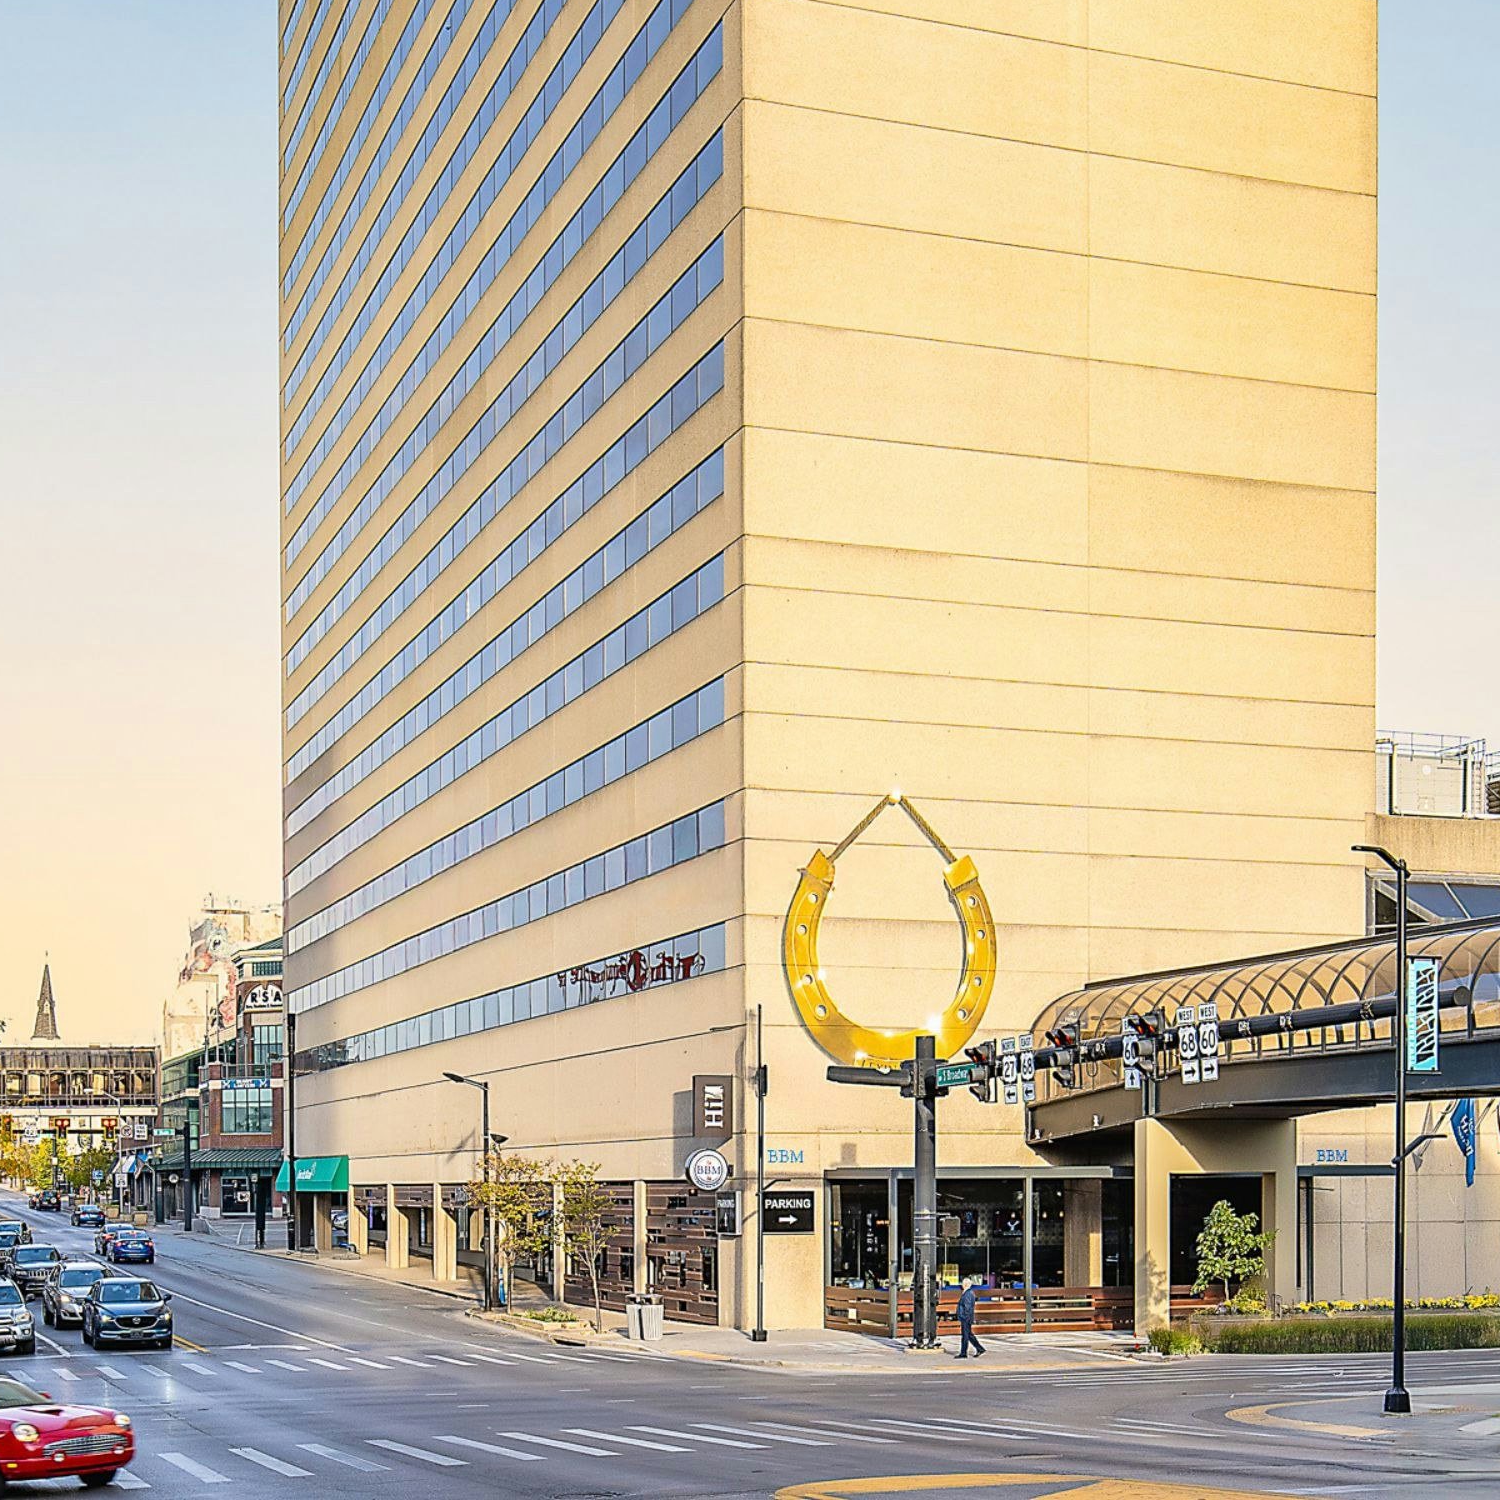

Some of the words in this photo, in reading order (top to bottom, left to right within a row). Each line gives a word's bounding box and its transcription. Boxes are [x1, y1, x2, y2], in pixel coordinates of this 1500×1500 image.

[1179, 1009, 1193, 1020] WEST
[1200, 1006, 1215, 1017] WEST
[1181, 1033, 1196, 1052] 68
[1201, 1029, 1216, 1049] 60
[1004, 1061, 1015, 1078] 27
[1023, 1057, 1033, 1076] 68
[767, 1149, 804, 1164] BBM
[1316, 1149, 1348, 1162] BBM
[764, 1198, 812, 1209] PARKING
